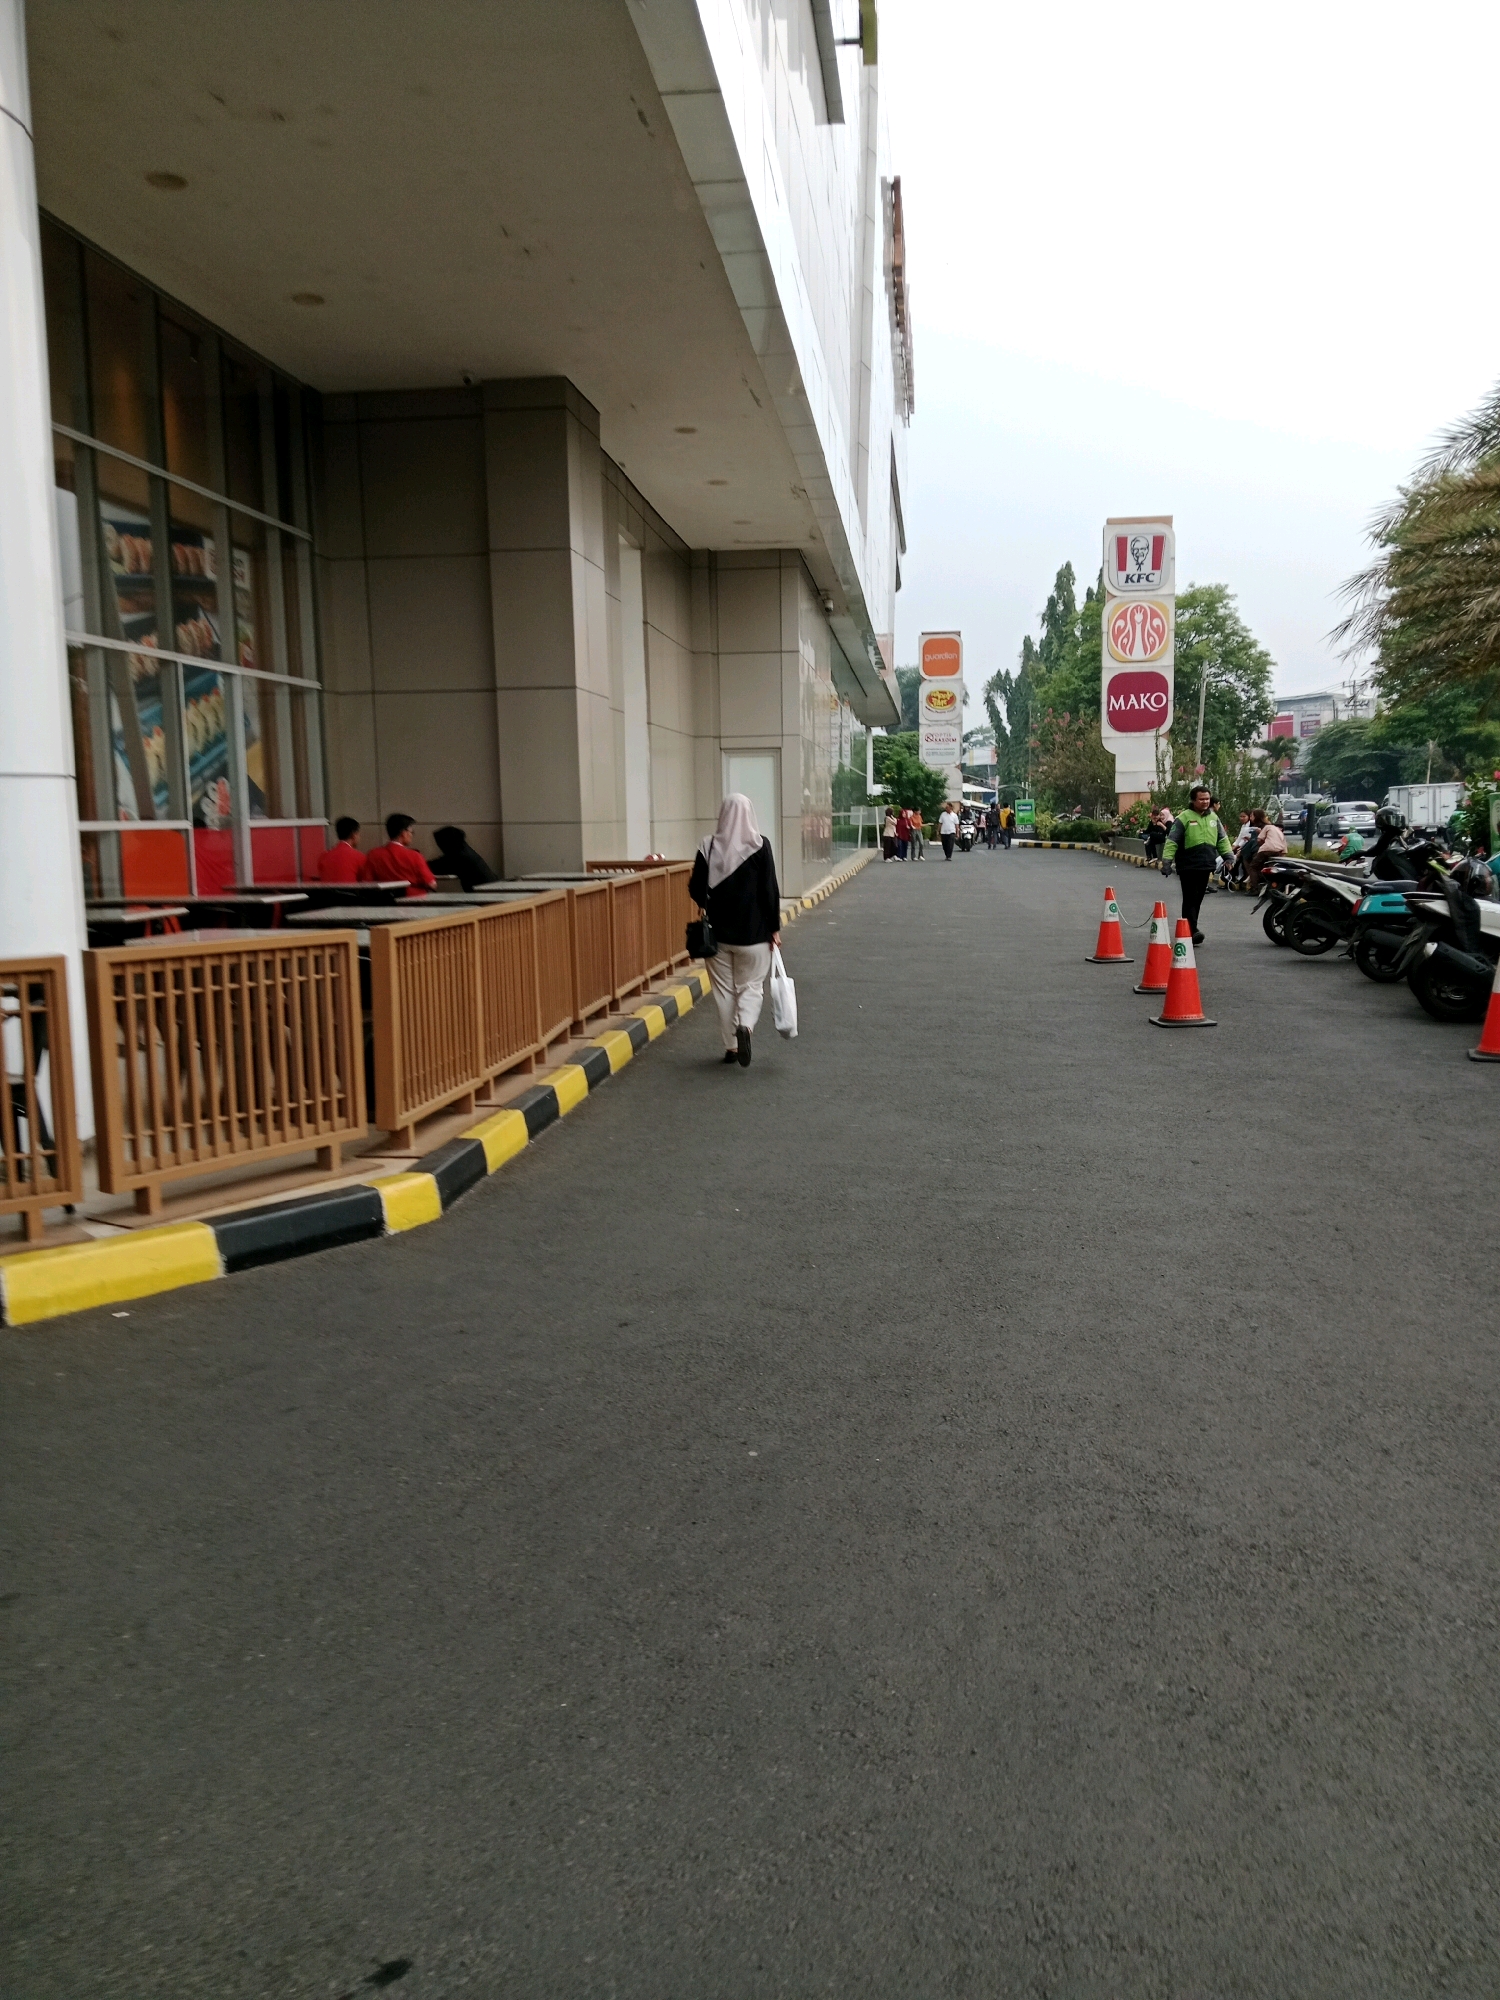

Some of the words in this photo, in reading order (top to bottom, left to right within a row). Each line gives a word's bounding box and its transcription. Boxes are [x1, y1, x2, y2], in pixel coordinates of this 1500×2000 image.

[1124, 572, 1155, 584] KFC
[924, 652, 958, 662] guardian
[1108, 691, 1167, 712] MAKO
